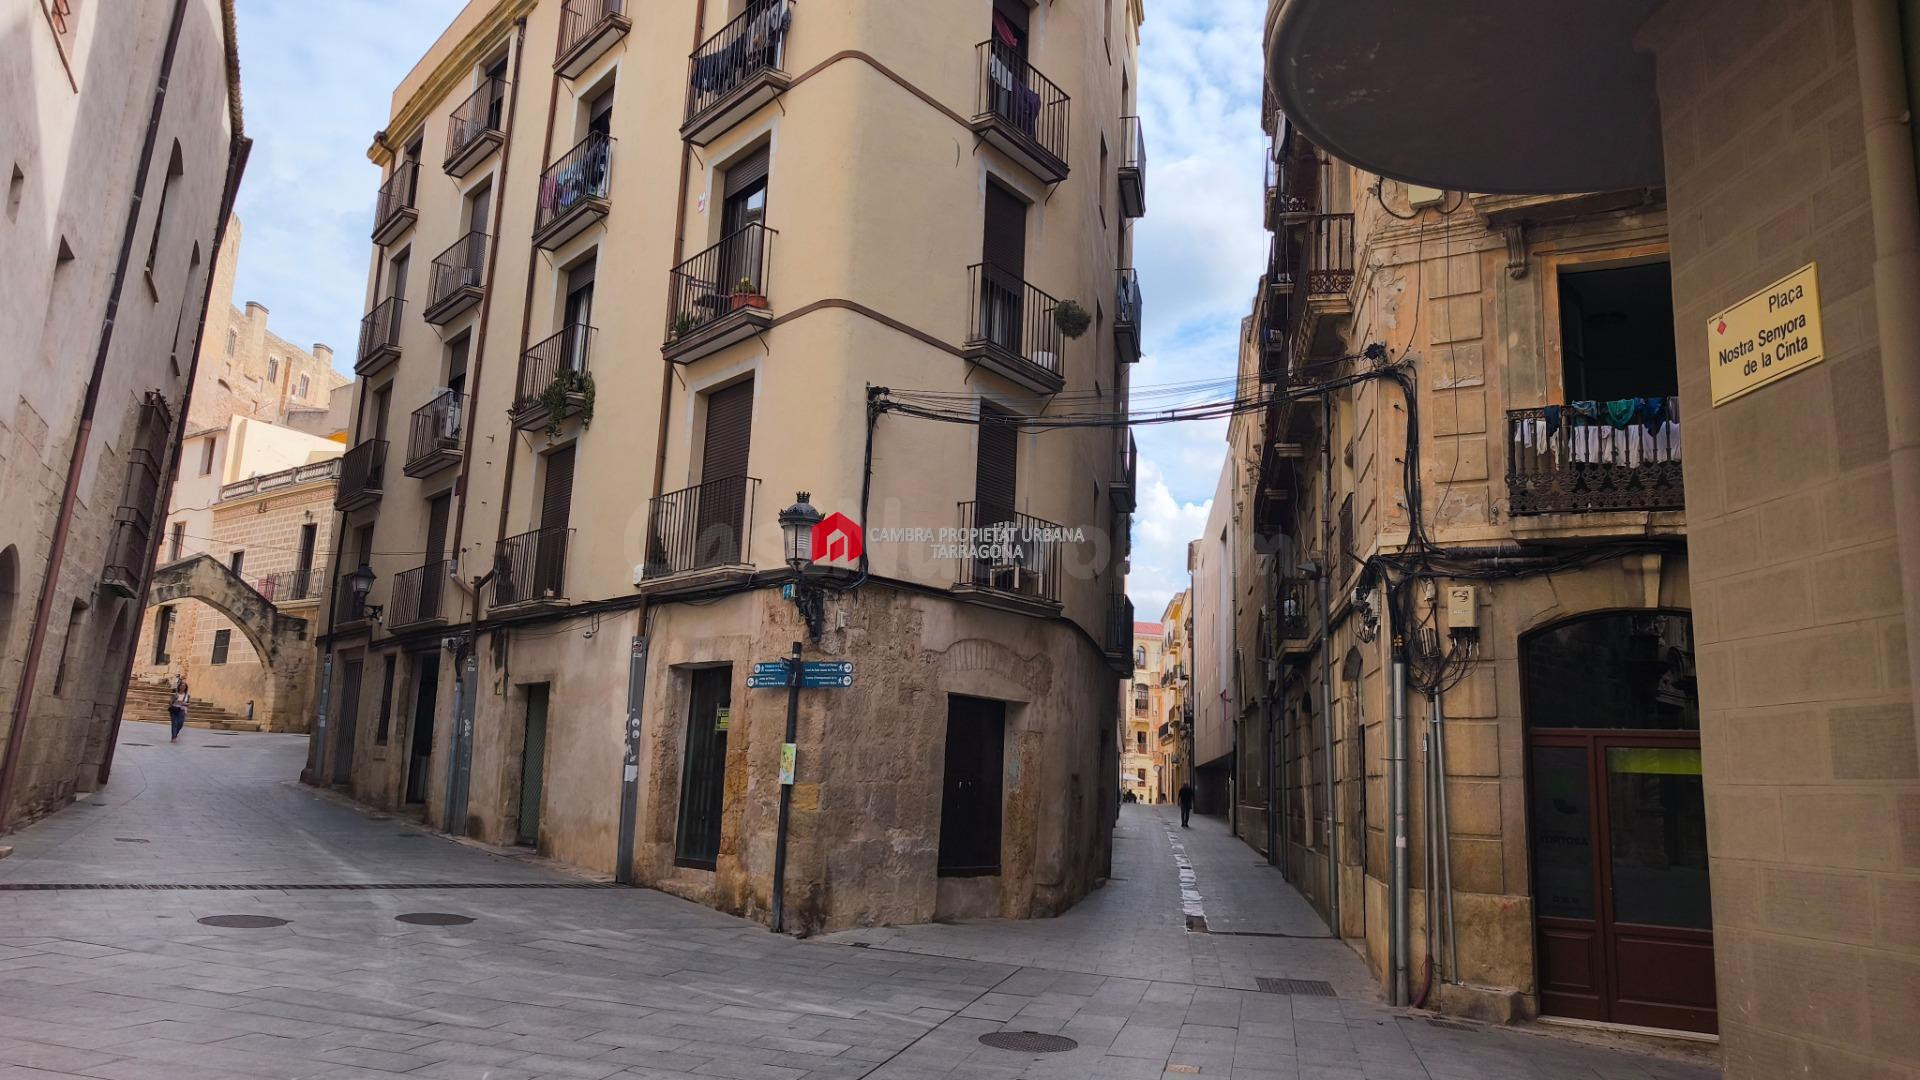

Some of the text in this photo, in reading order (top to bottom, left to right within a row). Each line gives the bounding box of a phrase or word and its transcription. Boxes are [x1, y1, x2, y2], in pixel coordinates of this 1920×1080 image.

[1719, 314, 1806, 367] Nostra Senyora
[1743, 336, 1808, 377] de la Cinta
